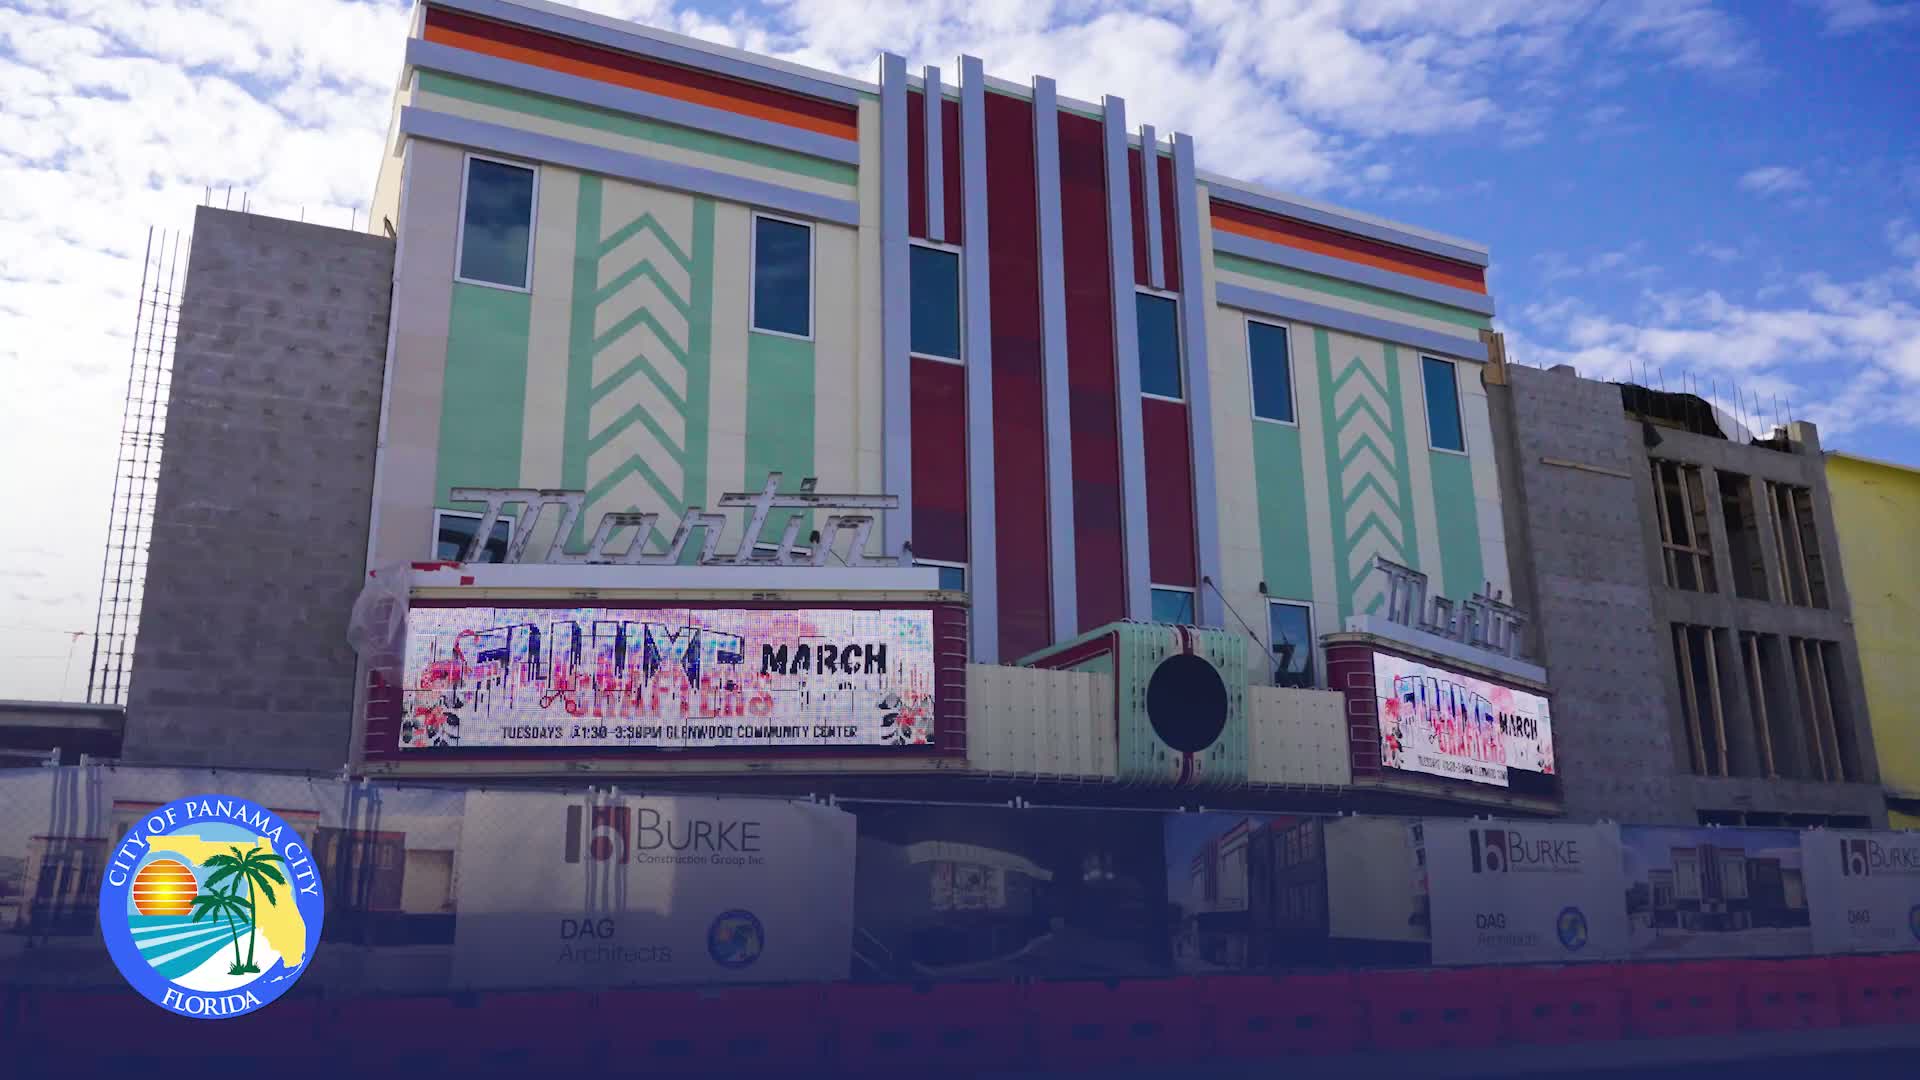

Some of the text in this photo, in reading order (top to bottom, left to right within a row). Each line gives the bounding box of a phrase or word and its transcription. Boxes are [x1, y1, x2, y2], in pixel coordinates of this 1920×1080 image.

[450, 471, 899, 567] Martin
[760, 643, 887, 675] MARCH
[502, 725, 564, 740] TUESDAYS
[666, 725, 733, 739] GLENWOOD
[737, 725, 808, 739] COMMUNITY
[813, 725, 858, 739] CENTER
[1499, 711, 1539, 741] MARCH
[637, 807, 761, 852] BURKE
[711, 854, 746, 867] Group
[1508, 831, 1580, 864] BURKE
[560, 918, 616, 940] DAG
[1475, 912, 1507, 929] DAG
[558, 943, 673, 964] Architects
